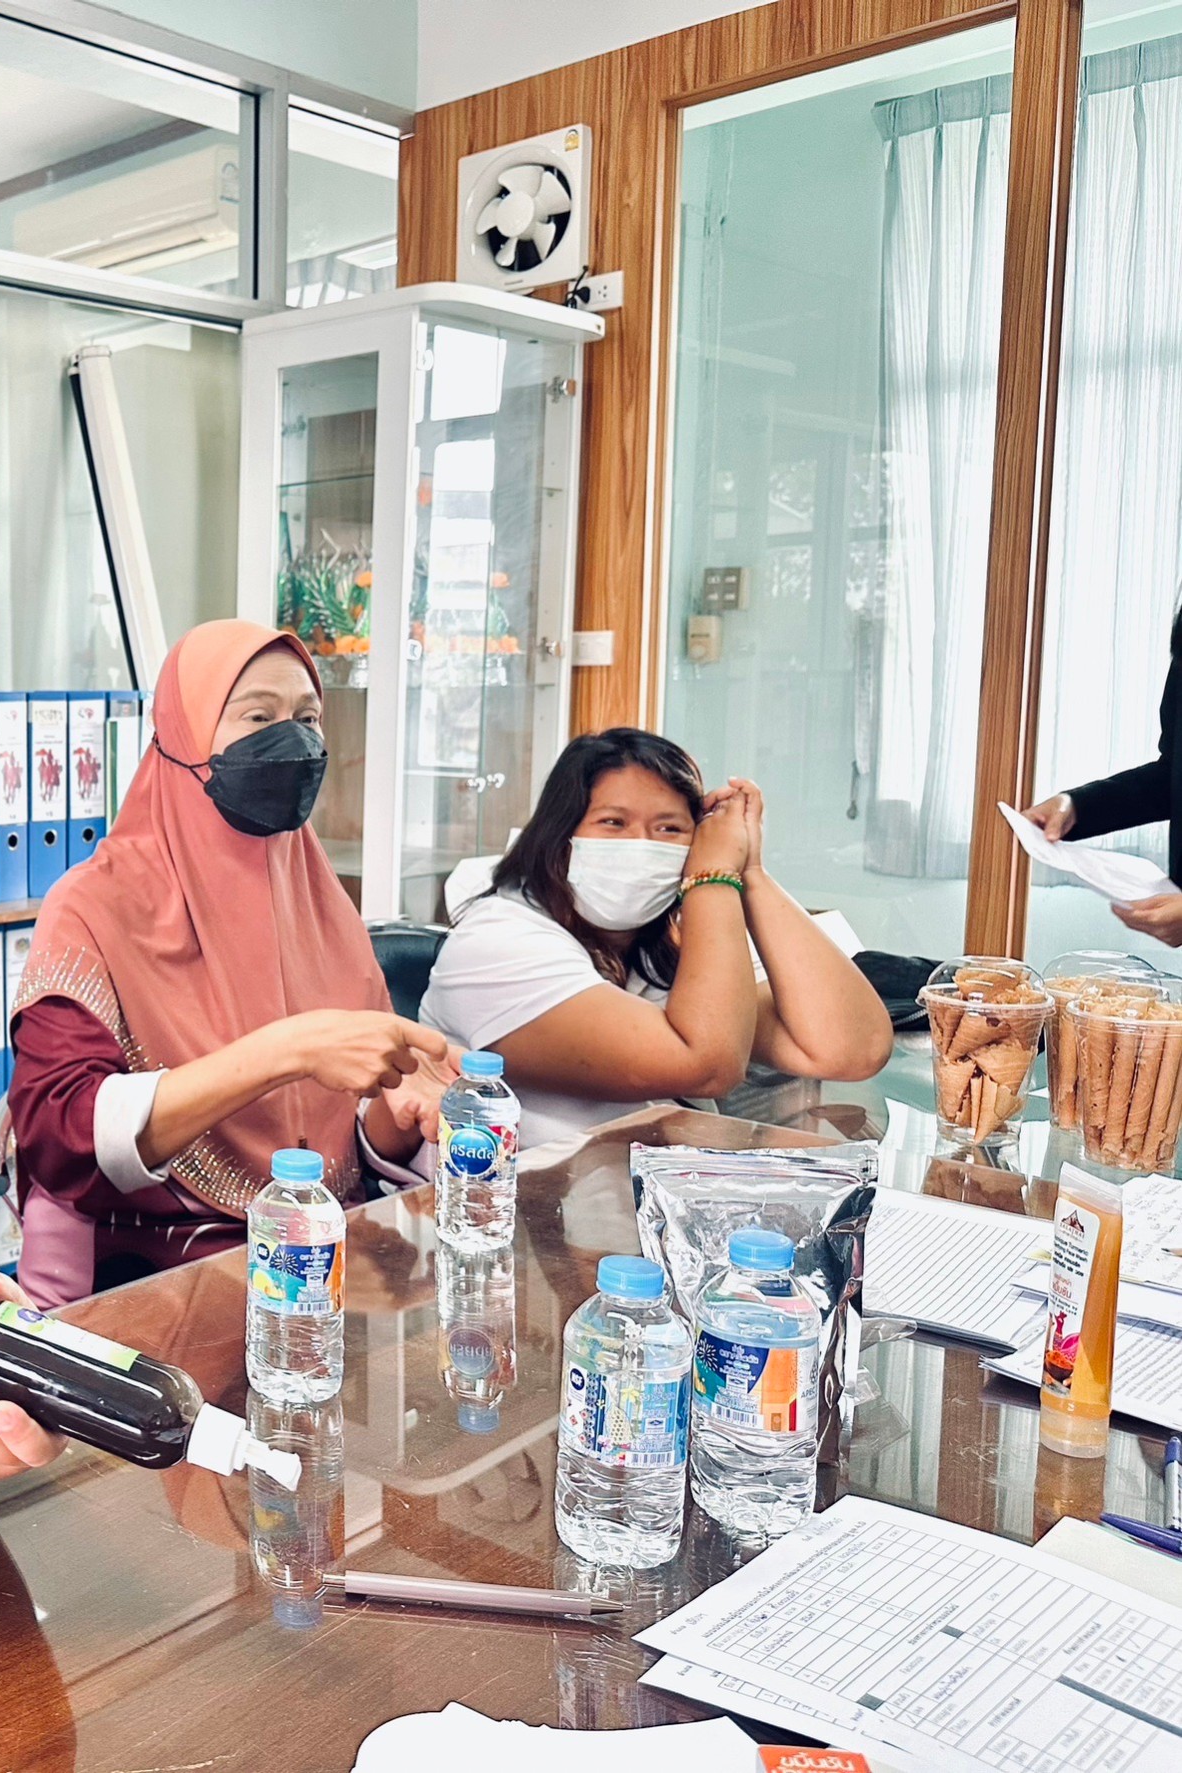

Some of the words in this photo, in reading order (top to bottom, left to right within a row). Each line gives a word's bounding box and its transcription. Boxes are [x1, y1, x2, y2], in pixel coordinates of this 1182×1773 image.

[451, 1144, 494, 1159] คริสตัล
[780, 1752, 855, 1771] ขมิ้นชัน
